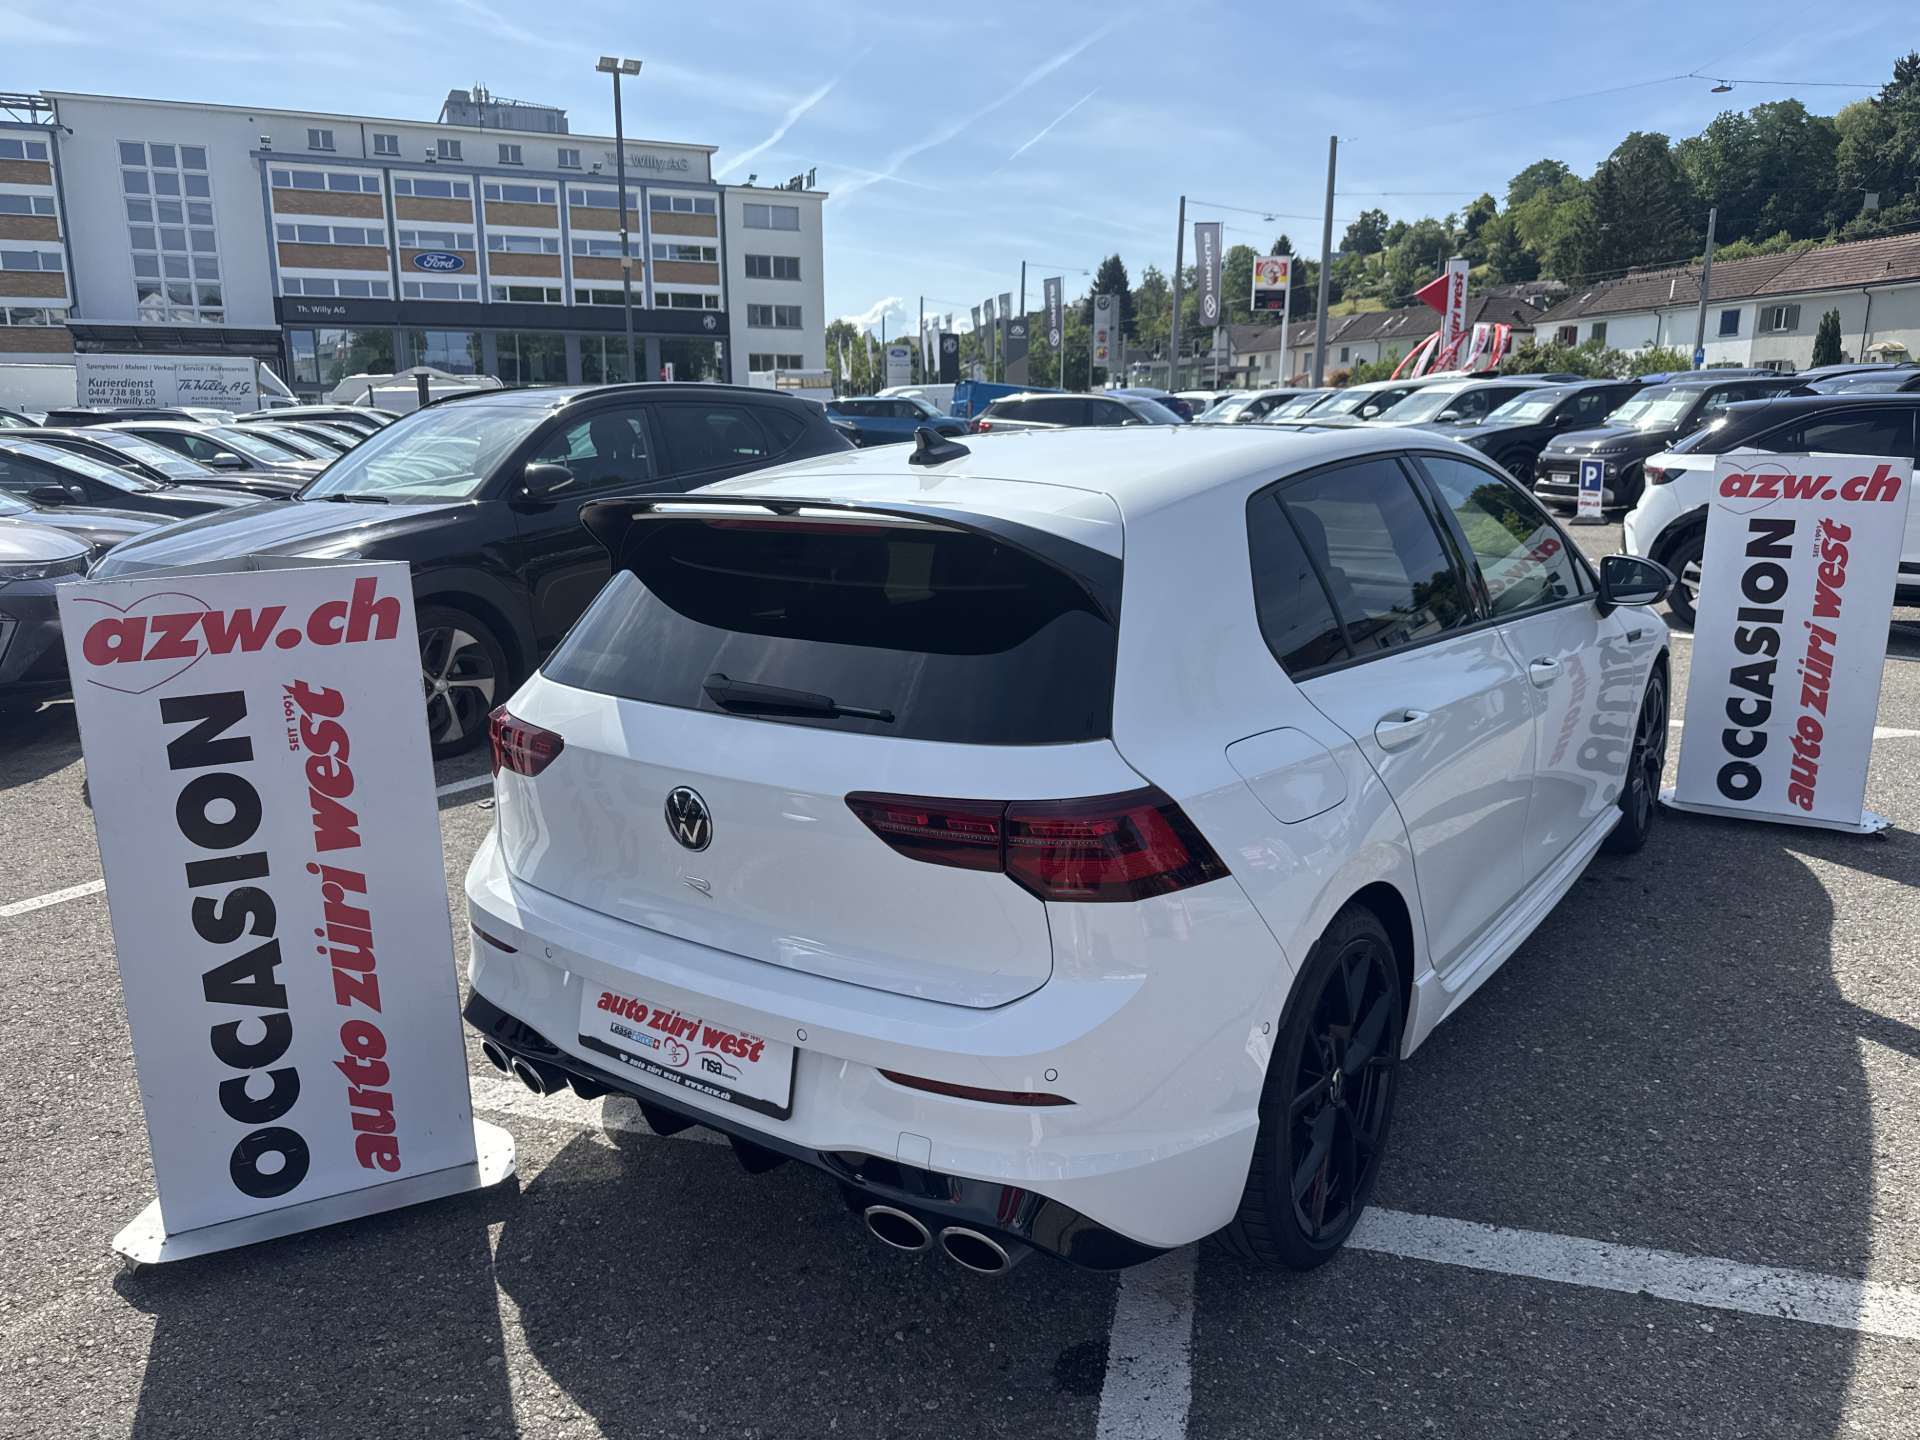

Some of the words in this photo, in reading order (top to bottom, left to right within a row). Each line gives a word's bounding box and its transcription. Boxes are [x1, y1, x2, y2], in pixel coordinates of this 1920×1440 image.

[631, 152, 665, 173] Willy
[667, 158, 689, 171] AG
[423, 255, 455, 269] Ford
[311, 305, 332, 315] Willy
[333, 306, 346, 314] AG
[88, 378, 154, 388] Kurierdienst
[88, 388, 106, 396] 044
[109, 388, 127, 396] 738
[129, 388, 141, 396] 88
[144, 388, 156, 397] 50
[88, 397, 156, 406] www.thwilly.ch
[1585, 466, 1597, 487] P
[1719, 464, 1902, 502] azw.ch
[1812, 543, 1820, 558] SEIT
[1812, 517, 1852, 619] west
[82, 576, 400, 667] azw.ch
[1716, 518, 1796, 801] OCCASION
[1797, 620, 1837, 718] züri
[283, 694, 297, 723] 1991
[289, 726, 300, 752] SEIT
[282, 679, 362, 853] west
[1788, 715, 1824, 812] auto
[159, 690, 311, 1199] OCCASION
[306, 862, 383, 1014] züri
[597, 992, 648, 1023] auto
[647, 1009, 702, 1041] züri
[702, 1026, 766, 1062] west
[630, 1057, 646, 1069] auto
[663, 1070, 681, 1083] west
[684, 1078, 731, 1101] www.azw.ch
[701, 1057, 722, 1075] nsa
[333, 1019, 401, 1173] auto
